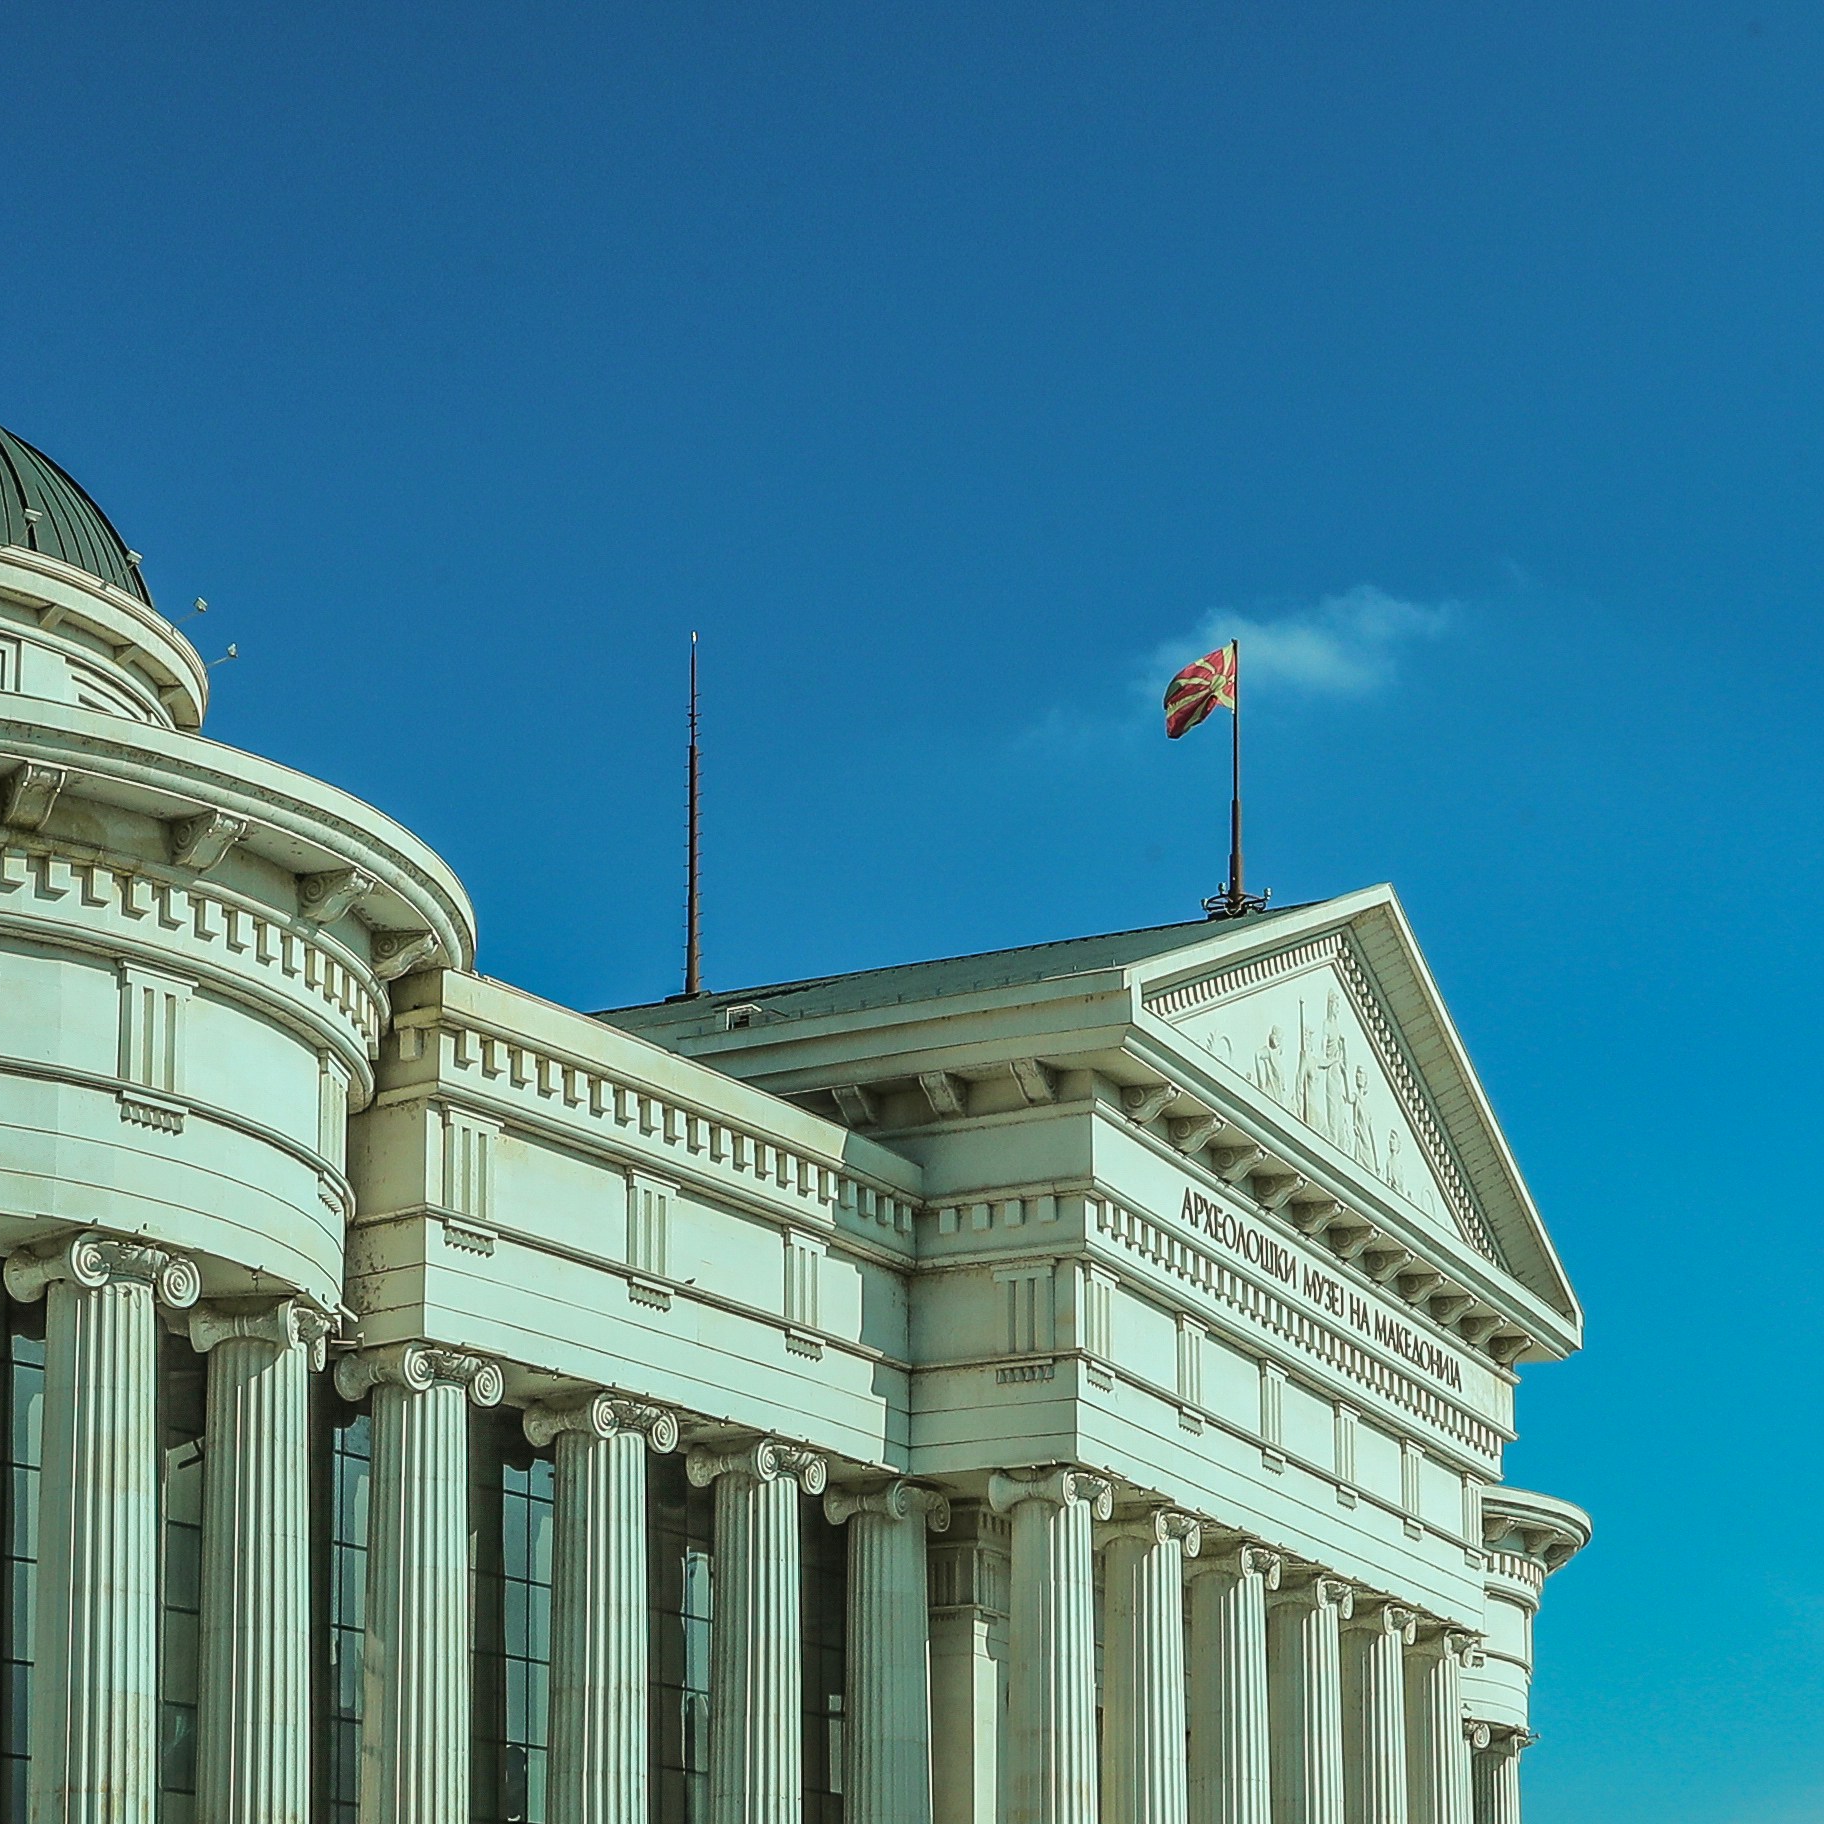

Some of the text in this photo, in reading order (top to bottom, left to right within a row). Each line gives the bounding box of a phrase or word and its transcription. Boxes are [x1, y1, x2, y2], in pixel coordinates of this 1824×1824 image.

[1181, 1187, 1462, 1393] АРХЕОЛОШКИ МУЗЕЈ НА МАКЕДОНИЈА
